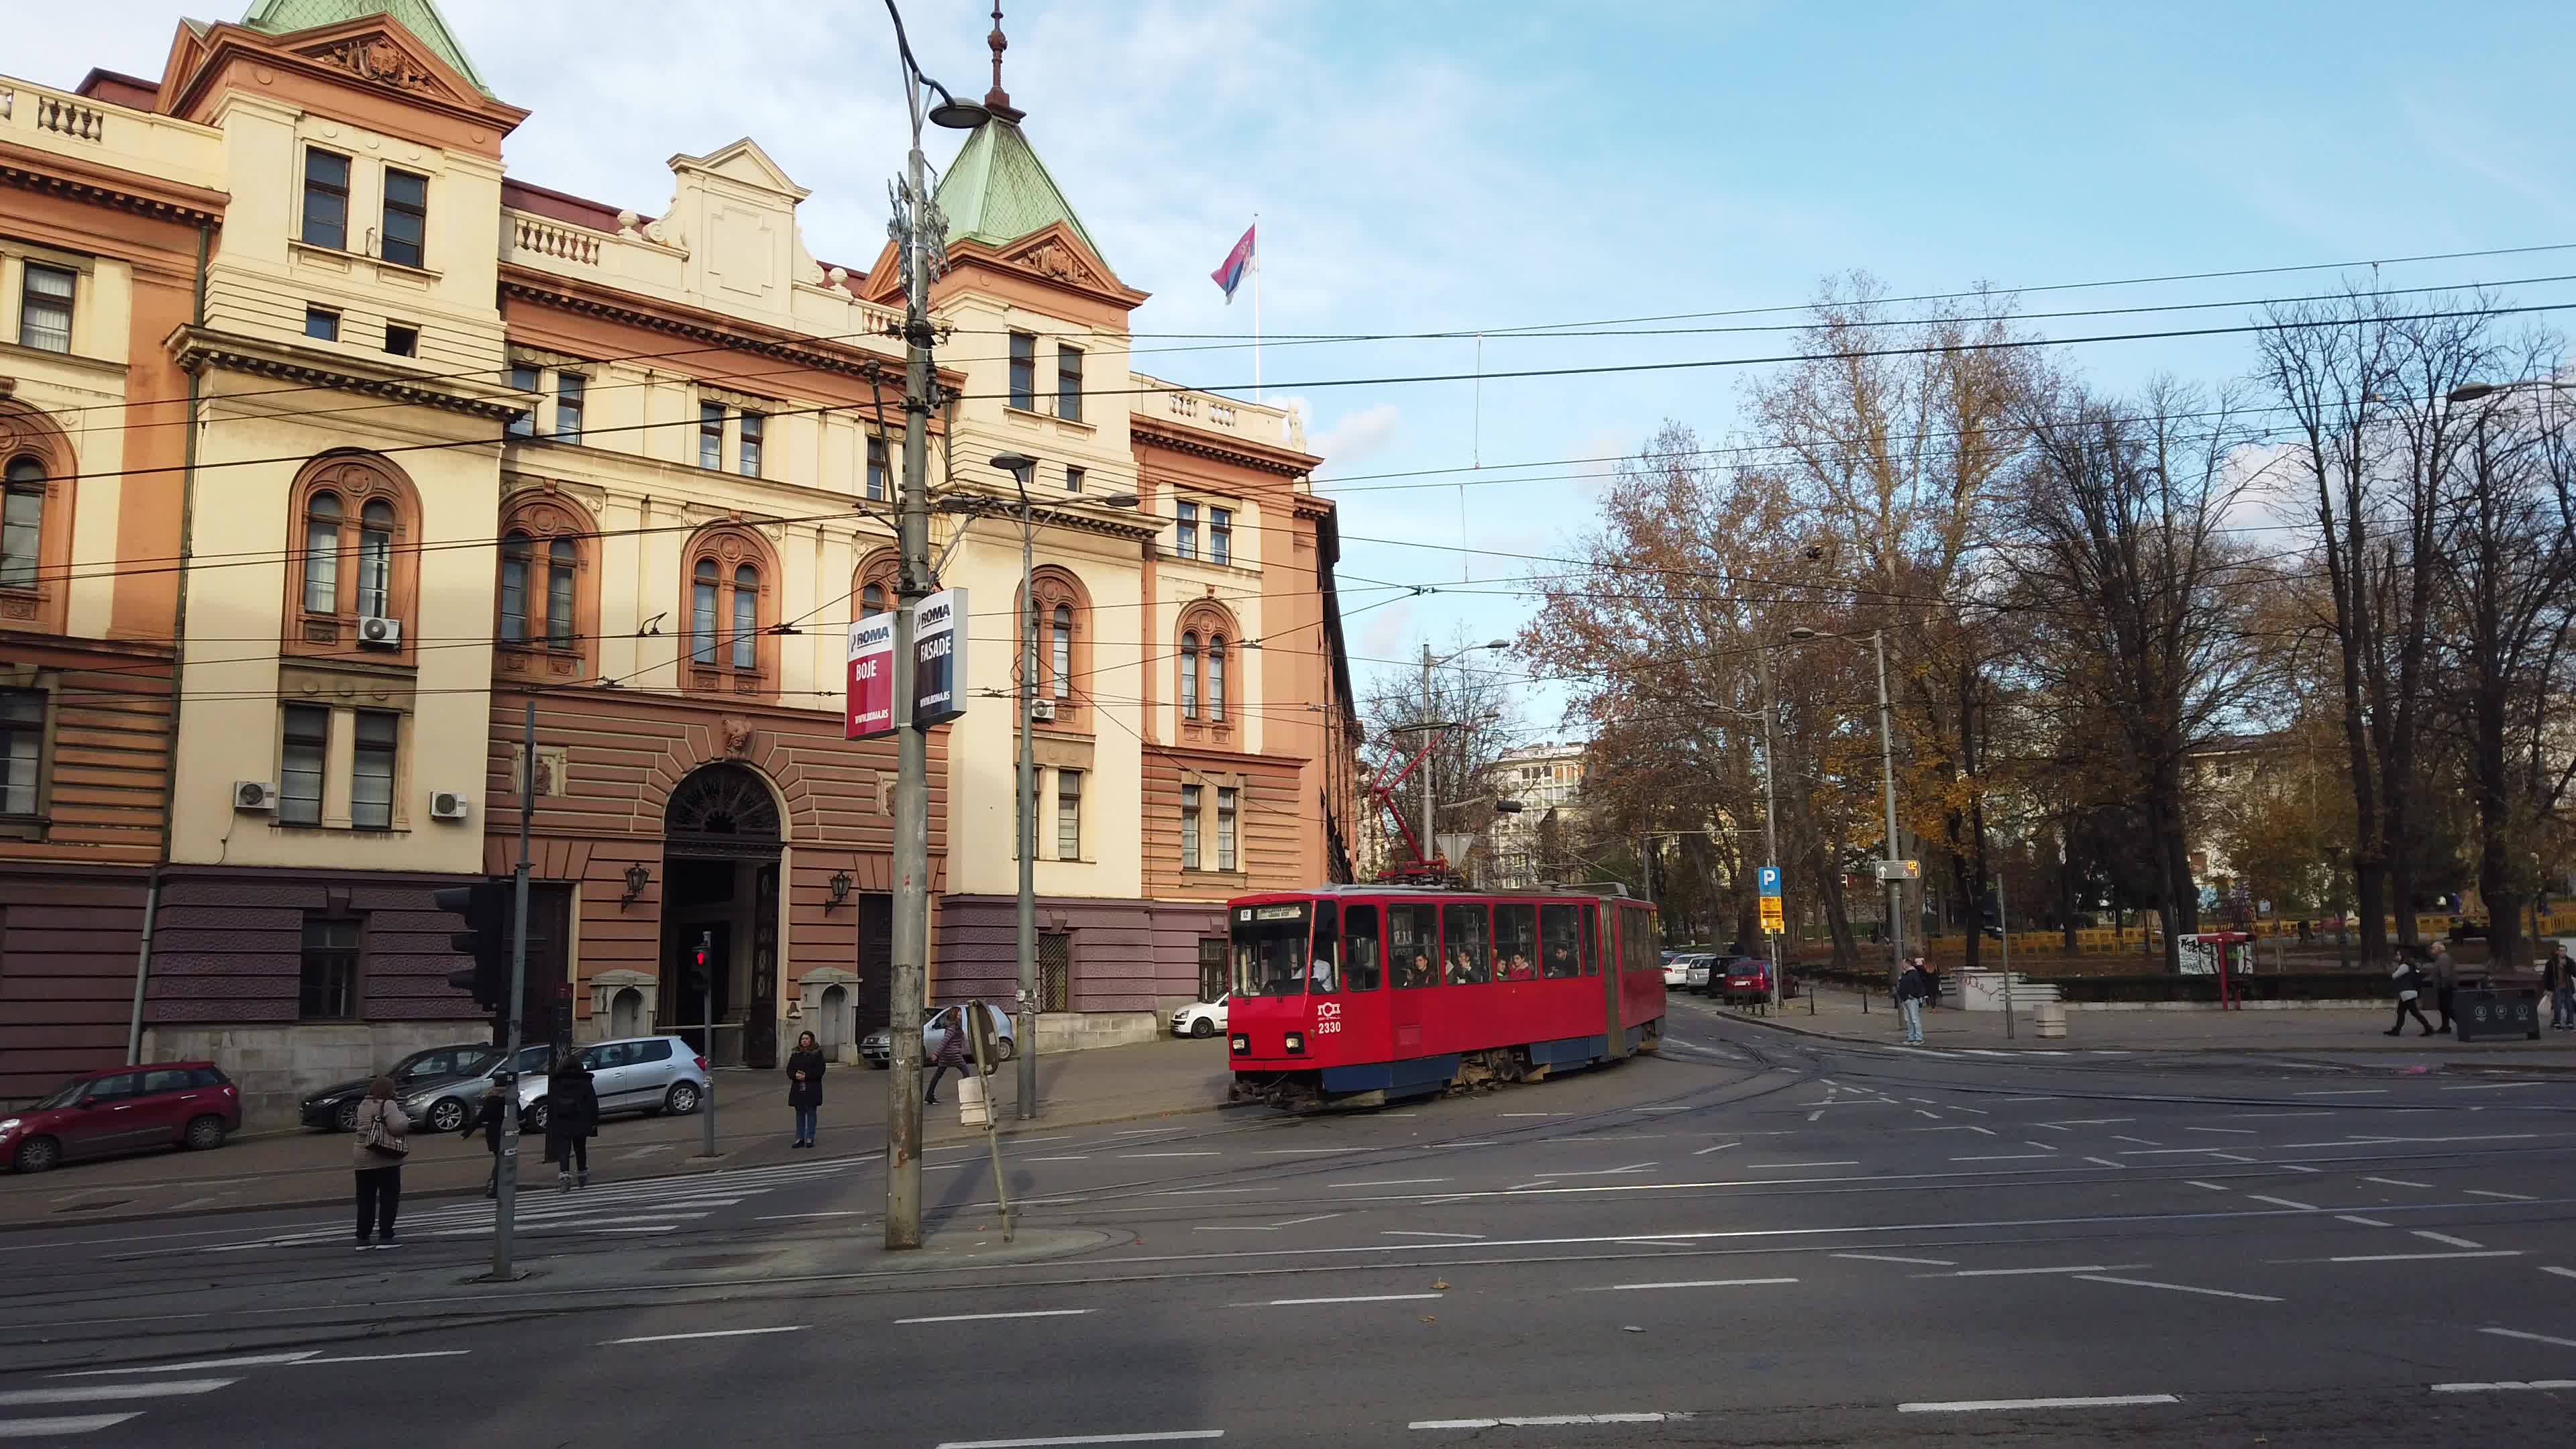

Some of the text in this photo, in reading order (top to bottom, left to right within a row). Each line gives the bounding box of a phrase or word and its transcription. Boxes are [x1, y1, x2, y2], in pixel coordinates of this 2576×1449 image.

[921, 603, 951, 626] ROMA
[857, 626, 890, 646] ROMA
[920, 635, 951, 663] FASADE
[856, 659, 877, 682] BOJE
[1764, 869, 1776, 885] P
[1318, 1021, 1341, 1034] 2330
